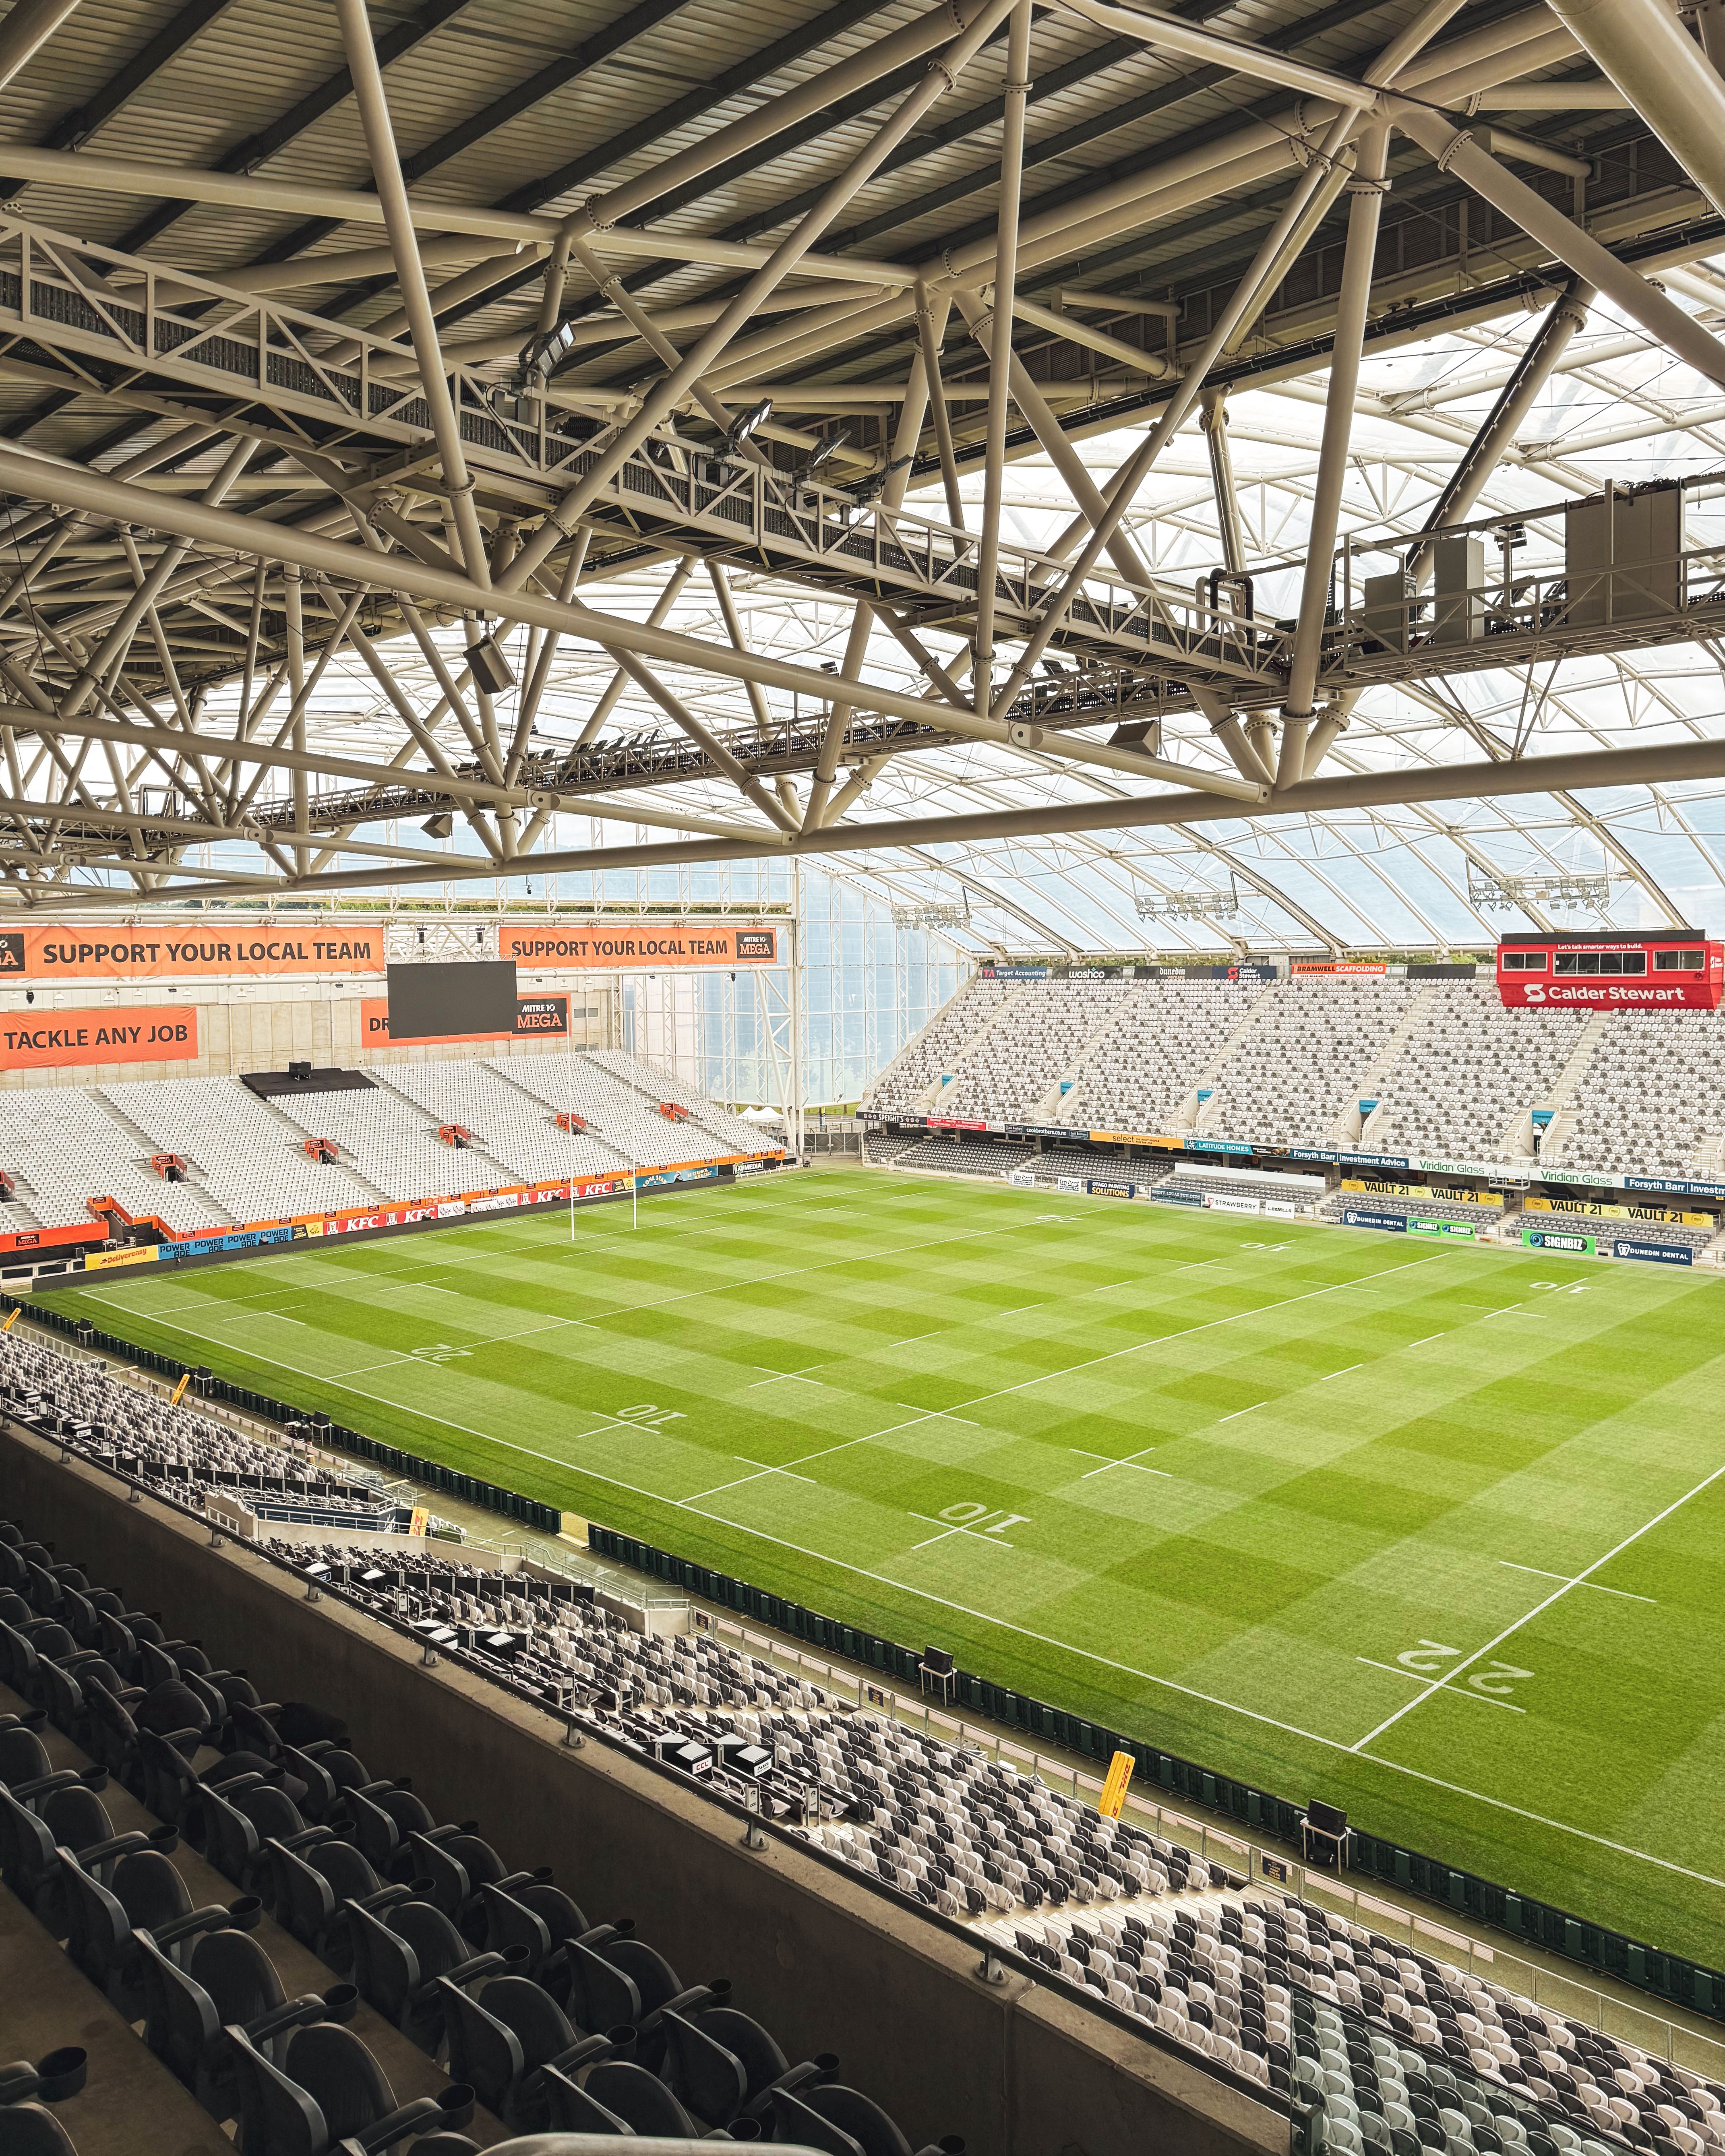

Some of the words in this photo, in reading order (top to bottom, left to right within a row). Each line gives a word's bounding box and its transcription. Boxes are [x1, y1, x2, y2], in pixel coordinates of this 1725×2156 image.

[43, 943, 160, 963] SUPPORT
[165, 943, 232, 961] YOUR
[237, 943, 308, 961] LOCAL
[313, 942, 371, 959] TEAM
[511, 941, 589, 956] SUPPORT
[592, 941, 635, 956] YOUR
[639, 941, 686, 955] LOCAL
[689, 940, 727, 954] TEAM
[740, 944, 771, 955] MEGA
[1069, 968, 1105, 979] washco
[1548, 986, 1606, 1000] Calder
[1608, 987, 1685, 1000] Stewart
[521, 1005, 546, 1013] MITRE
[517, 1013, 563, 1029] MEGA
[3, 1029, 89, 1050] TACKLE
[95, 1026, 142, 1045] ANY
[147, 1025, 188, 1043] JOB
[878, 1114, 904, 1122] SPEIGHT'S
[1026, 1128, 1067, 1136] cookbrothers.co.nz
[1113, 1134, 1134, 1143] select
[1293, 1150, 1319, 1160] Forsyth
[1320, 1152, 1335, 1160] Barr
[1339, 1154, 1380, 1164] Investment
[1419, 1160, 1454, 1172] Viridian
[1457, 1164, 1485, 1174] Glass
[1541, 1171, 1578, 1182] Viridian
[1582, 1175, 1613, 1185] Glass
[1629, 1179, 1662, 1190] Forsyth
[1665, 1182, 1685, 1191] Barr
[584, 1182, 610, 1196] KFC
[1092, 1187, 1129, 1197] SOLUTIONS
[1364, 1182, 1396, 1194] VAULT
[1398, 1185, 1409, 1195] 21
[1431, 1188, 1465, 1201] VAULT
[1467, 1192, 1479, 1202] 21
[536, 1189, 564, 1203] KFC
[1215, 1200, 1256, 1209] STRAWBERRY
[1549, 1200, 1587, 1213] VAULT
[1589, 1205, 1602, 1215] 21
[404, 1207, 435, 1223] KFC
[1628, 1208, 1667, 1221] VAULT
[1669, 1212, 1683, 1223] 21
[346, 1215, 379, 1232] KFC
[1417, 1222, 1438, 1230] SIGNBIZ
[1450, 1226, 1471, 1234] SIGNBIZ
[228, 1234, 256, 1243] POWER
[261, 1229, 288, 1239] POWER
[160, 1243, 190, 1253] POWER
[195, 1238, 223, 1248] POWER
[242, 1240, 256, 1248] ADE
[1544, 1236, 1583, 1250] SIGNBIZ
[107, 1249, 147, 1263] Delivereasy
[1630, 1249, 1660, 1257] DUNEDIN
[1662, 1251, 1688, 1260] DENTAL
[939, 1502, 1032, 1533] 10
[1396, 1639, 1535, 1694] 22
[696, 1761, 709, 1771] CCL
[1119, 1763, 1130, 1789] DHL
